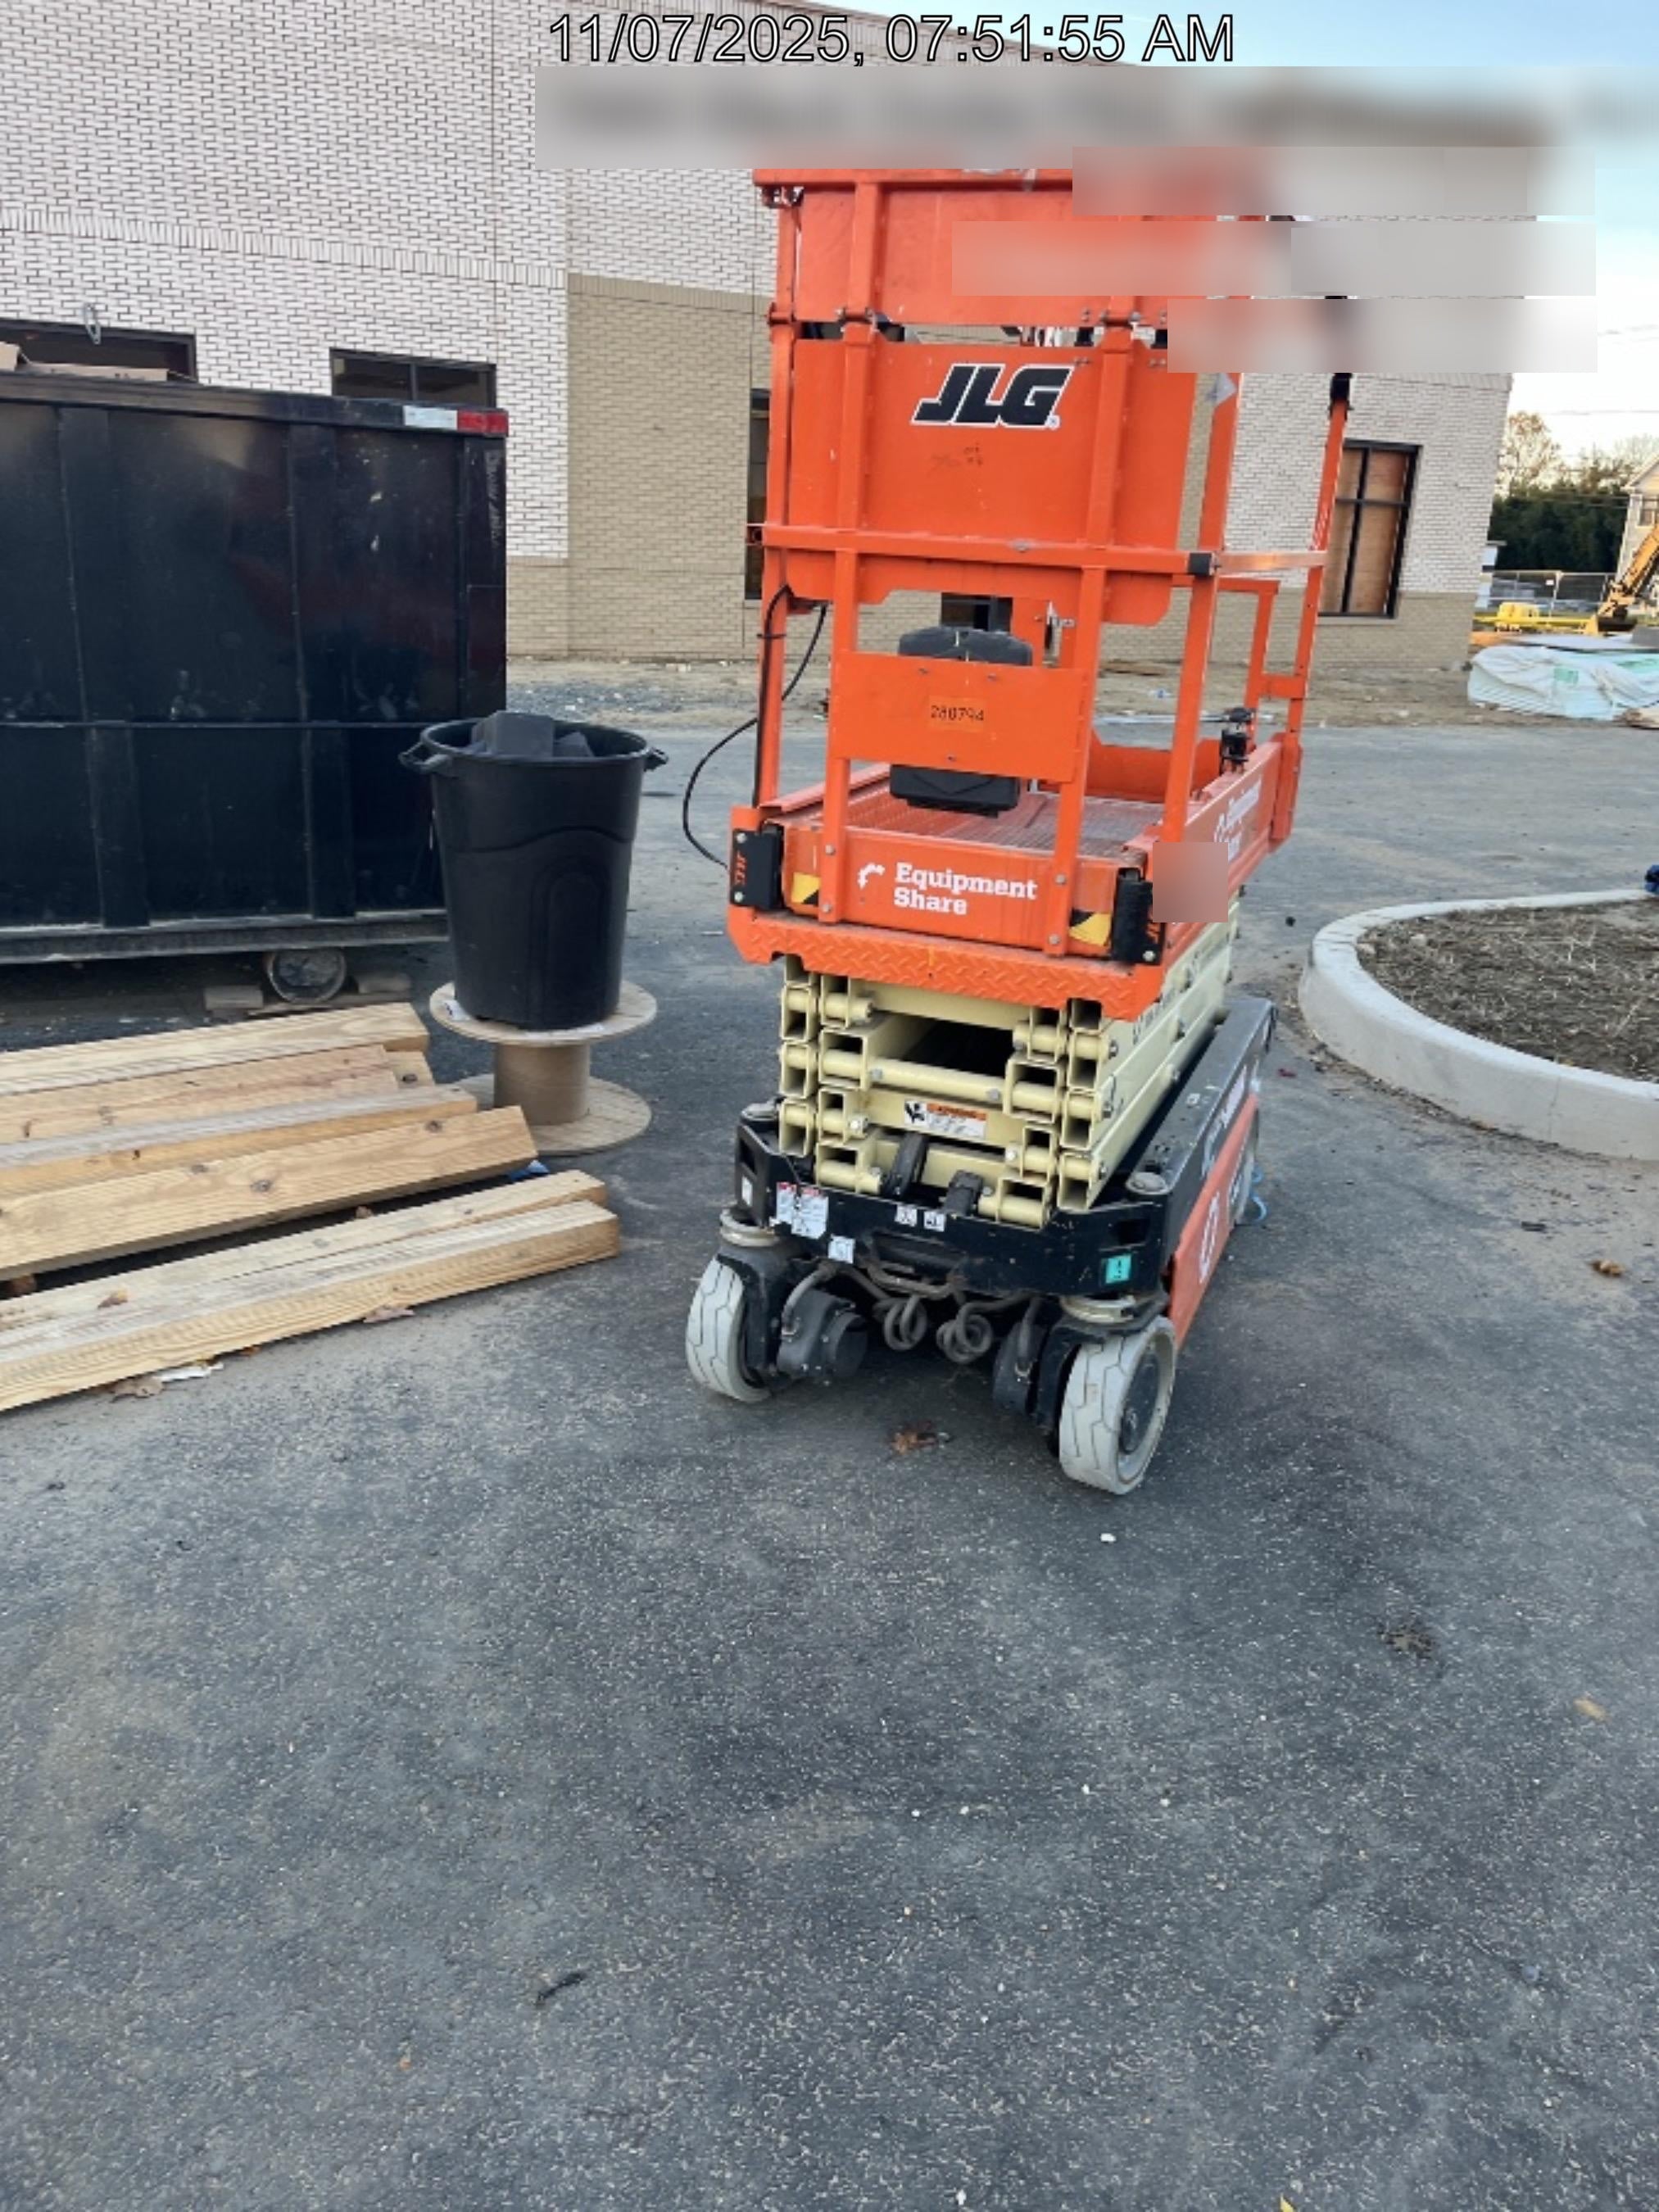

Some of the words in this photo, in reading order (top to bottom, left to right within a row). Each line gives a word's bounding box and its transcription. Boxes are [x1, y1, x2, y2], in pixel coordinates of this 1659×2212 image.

[911, 363, 1074, 429] JLG
[895, 862, 1038, 900] Equipment
[893, 886, 968, 916] Share
